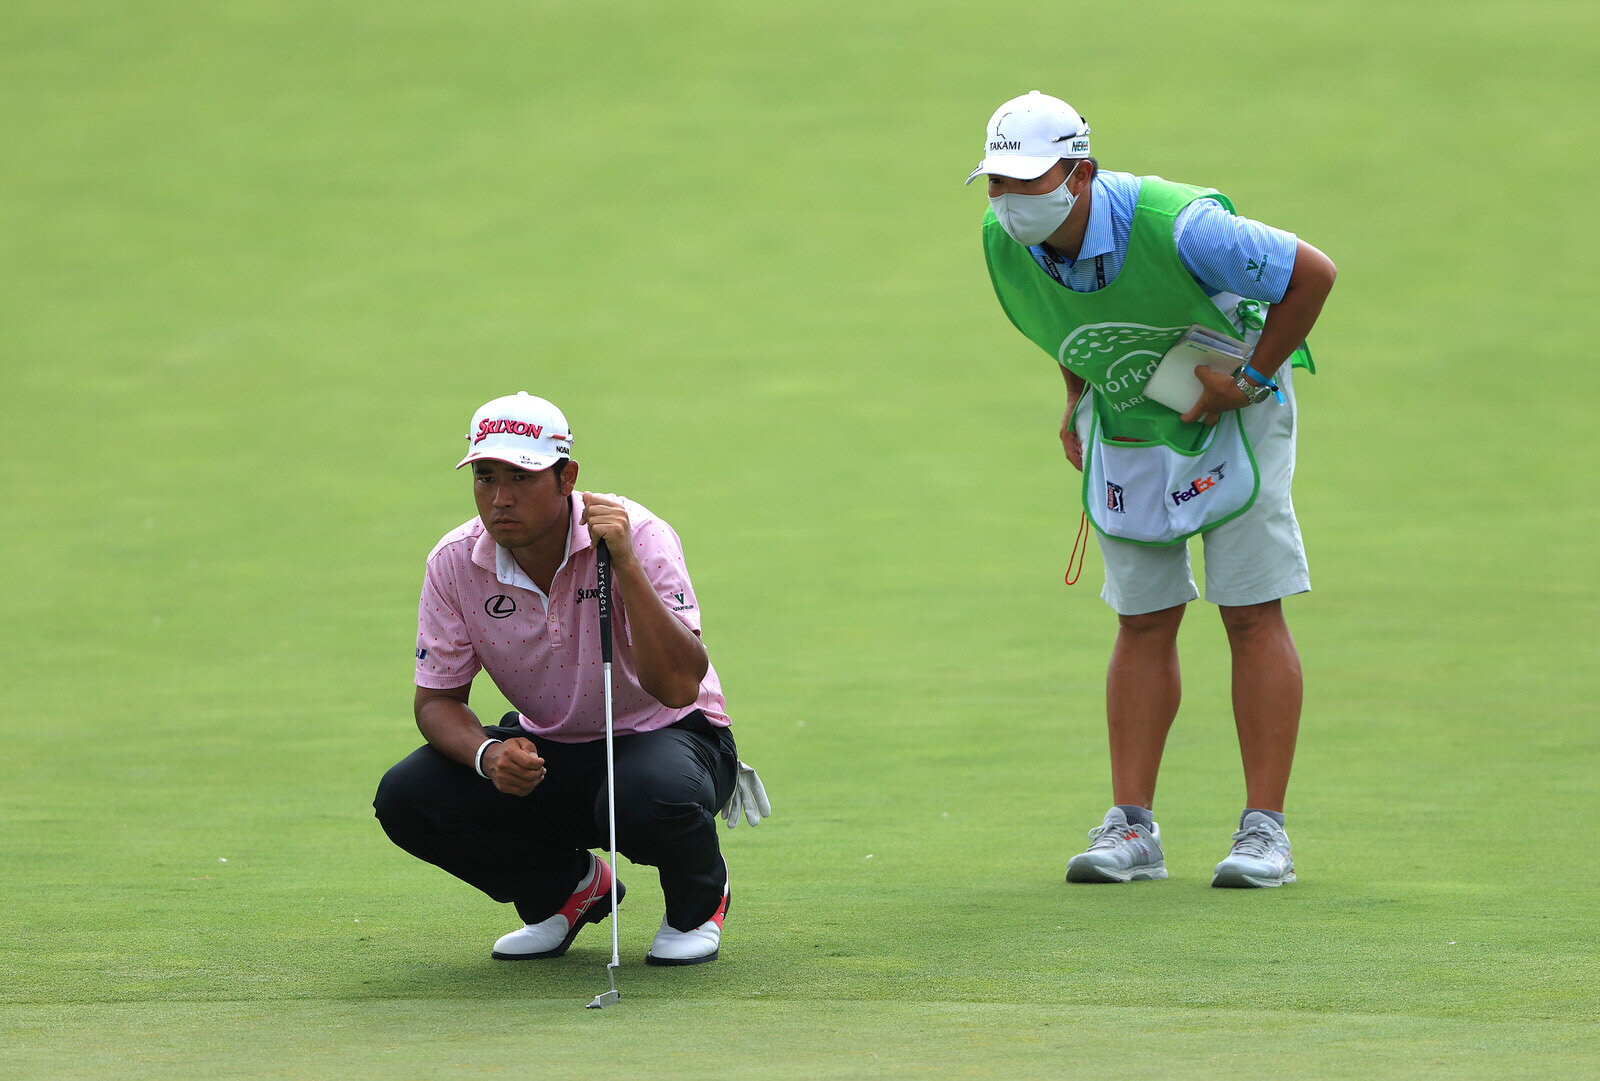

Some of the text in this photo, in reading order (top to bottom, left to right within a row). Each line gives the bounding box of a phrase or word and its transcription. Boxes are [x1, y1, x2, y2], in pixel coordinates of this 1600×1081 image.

[990, 141, 1021, 151] TAKAMI
[474, 418, 544, 446] SRIXON
[1171, 475, 1216, 506] FedEx
